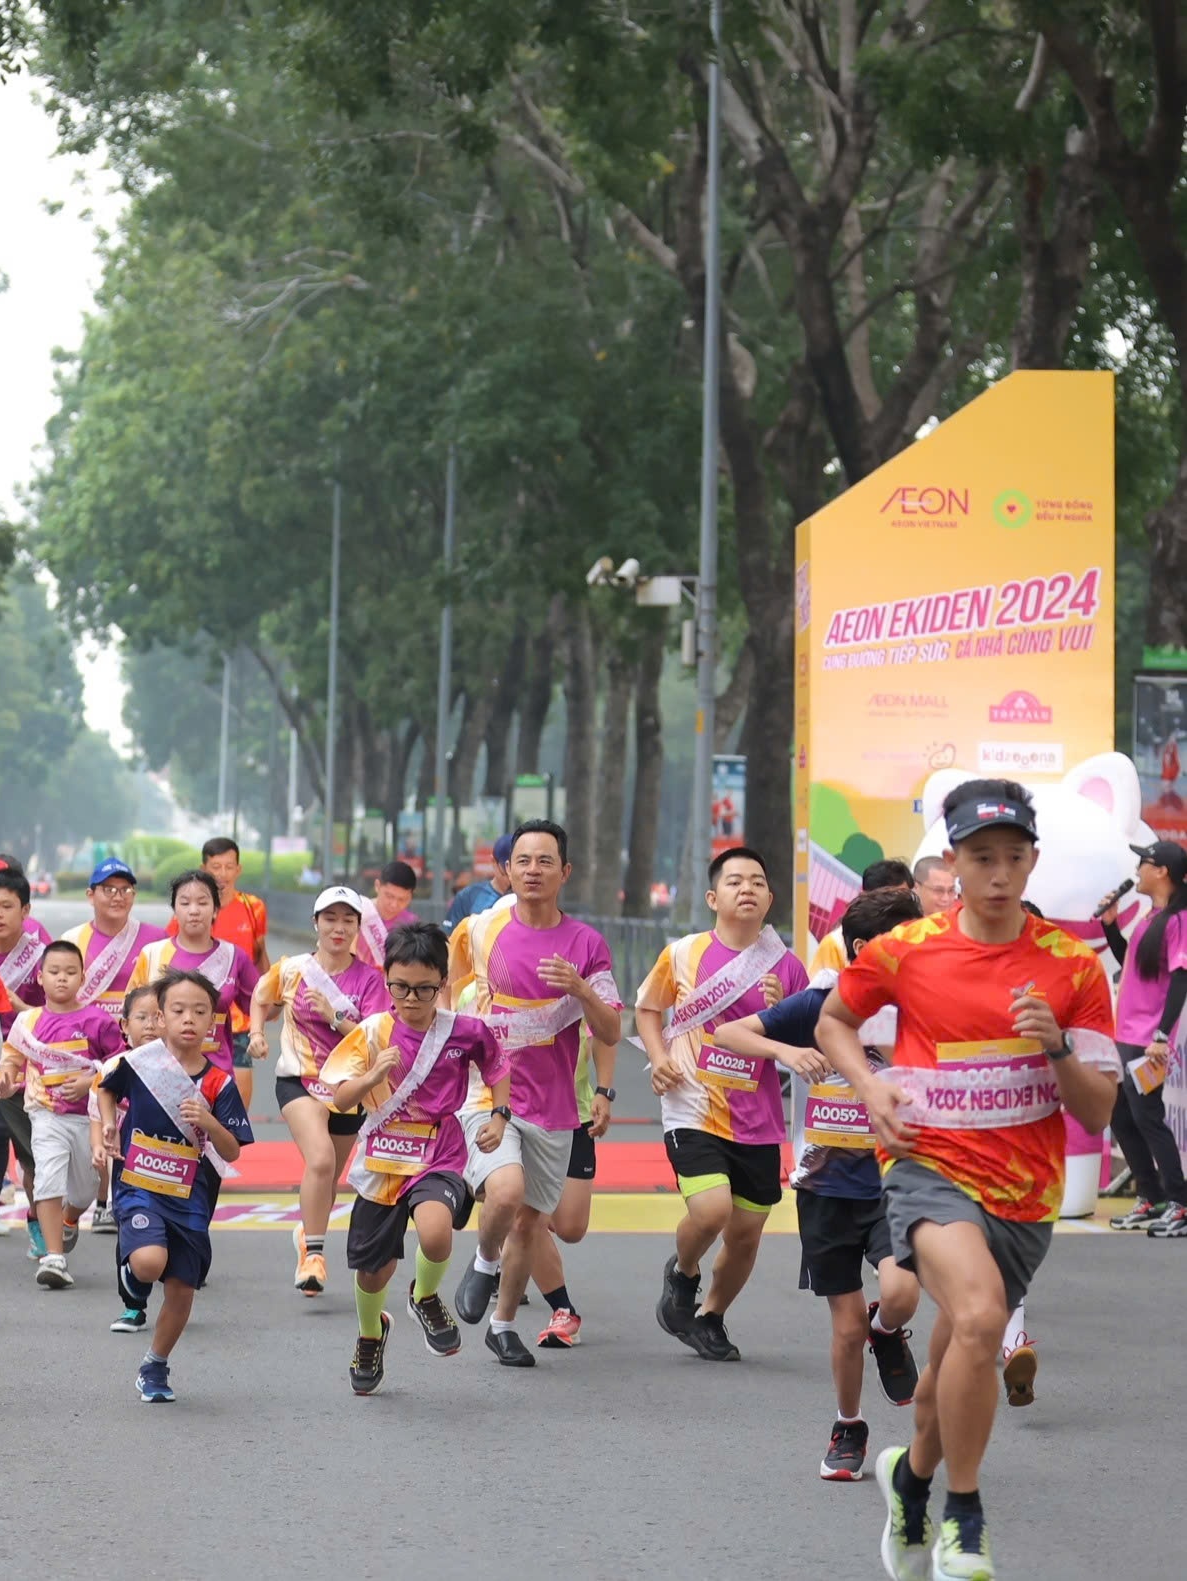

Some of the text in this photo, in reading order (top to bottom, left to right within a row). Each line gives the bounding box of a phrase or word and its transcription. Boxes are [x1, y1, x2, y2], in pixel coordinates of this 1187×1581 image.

[917, 520, 958, 528] VIETNAM
[825, 569, 1099, 647] AEON EKIDEN 2024
[918, 639, 951, 663] SỨC
[1058, 623, 1095, 652] VUI
[909, 693, 949, 708] MALL
[992, 708, 1050, 721] TOPVALU
[678, 994, 713, 1021] EKIDEN
[707, 976, 736, 1001] 2024
[706, 1052, 756, 1073] A0028-1
[925, 1086, 968, 1112] 2024
[971, 1086, 1034, 1111] EKIDEN
[371, 1136, 427, 1155] A0063-1
[133, 1152, 189, 1177] A0065-1
